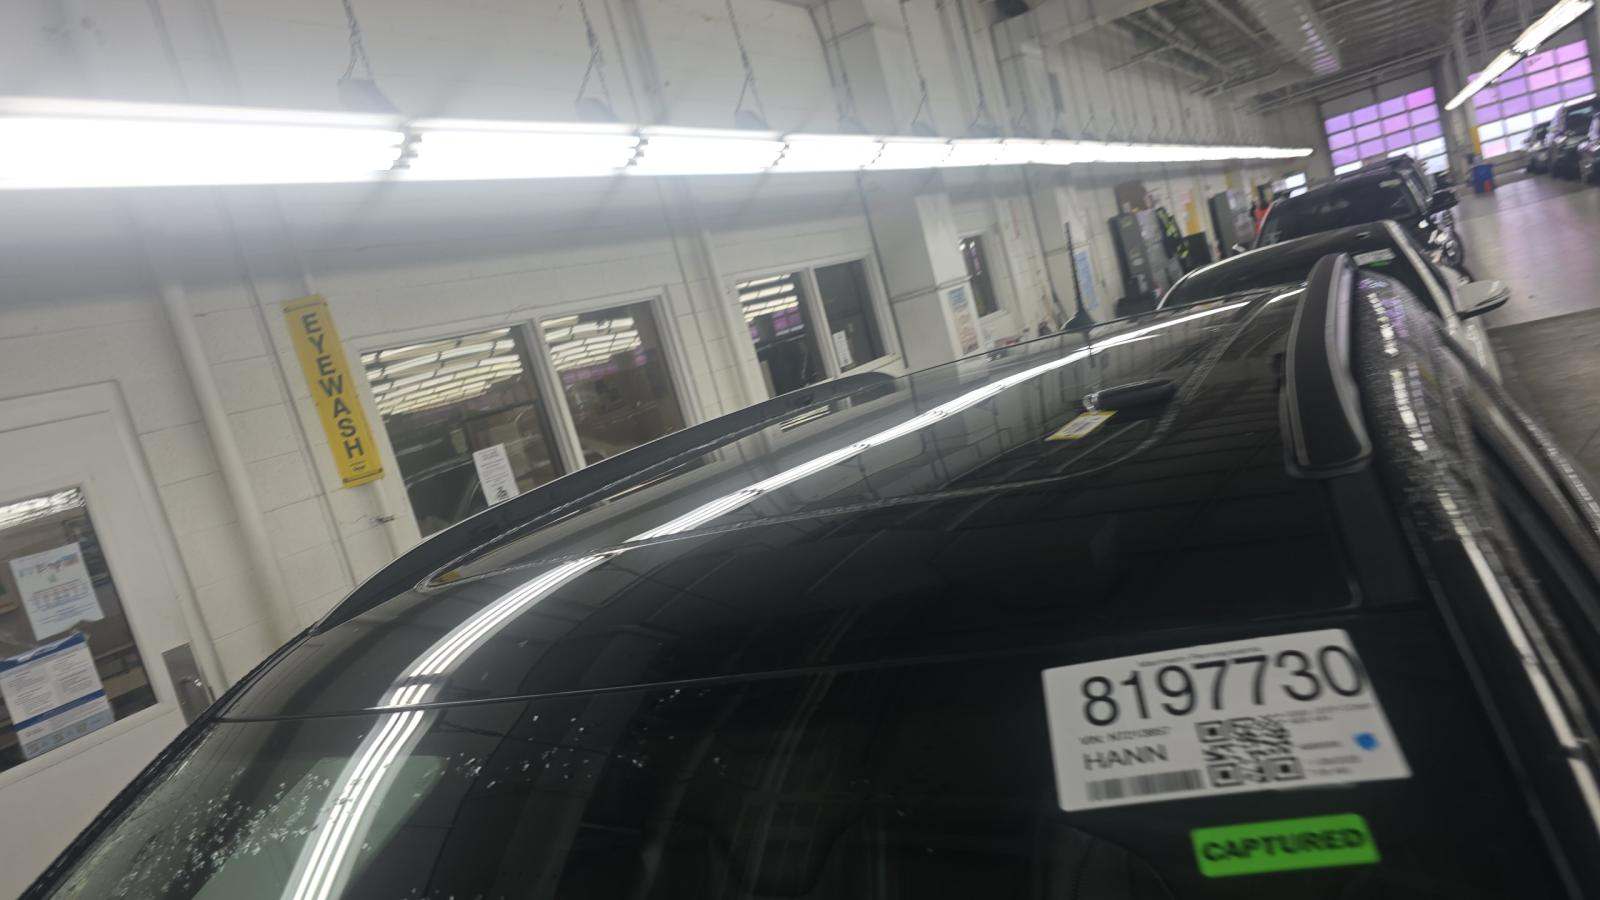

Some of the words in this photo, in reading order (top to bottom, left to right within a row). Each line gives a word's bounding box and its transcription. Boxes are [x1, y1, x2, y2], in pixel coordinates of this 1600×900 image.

[301, 312, 365, 459] EYEWASH
[1080, 644, 1366, 727] 8197730
[1083, 744, 1168, 771] HANN
[1202, 827, 1367, 862] CAPTURED
